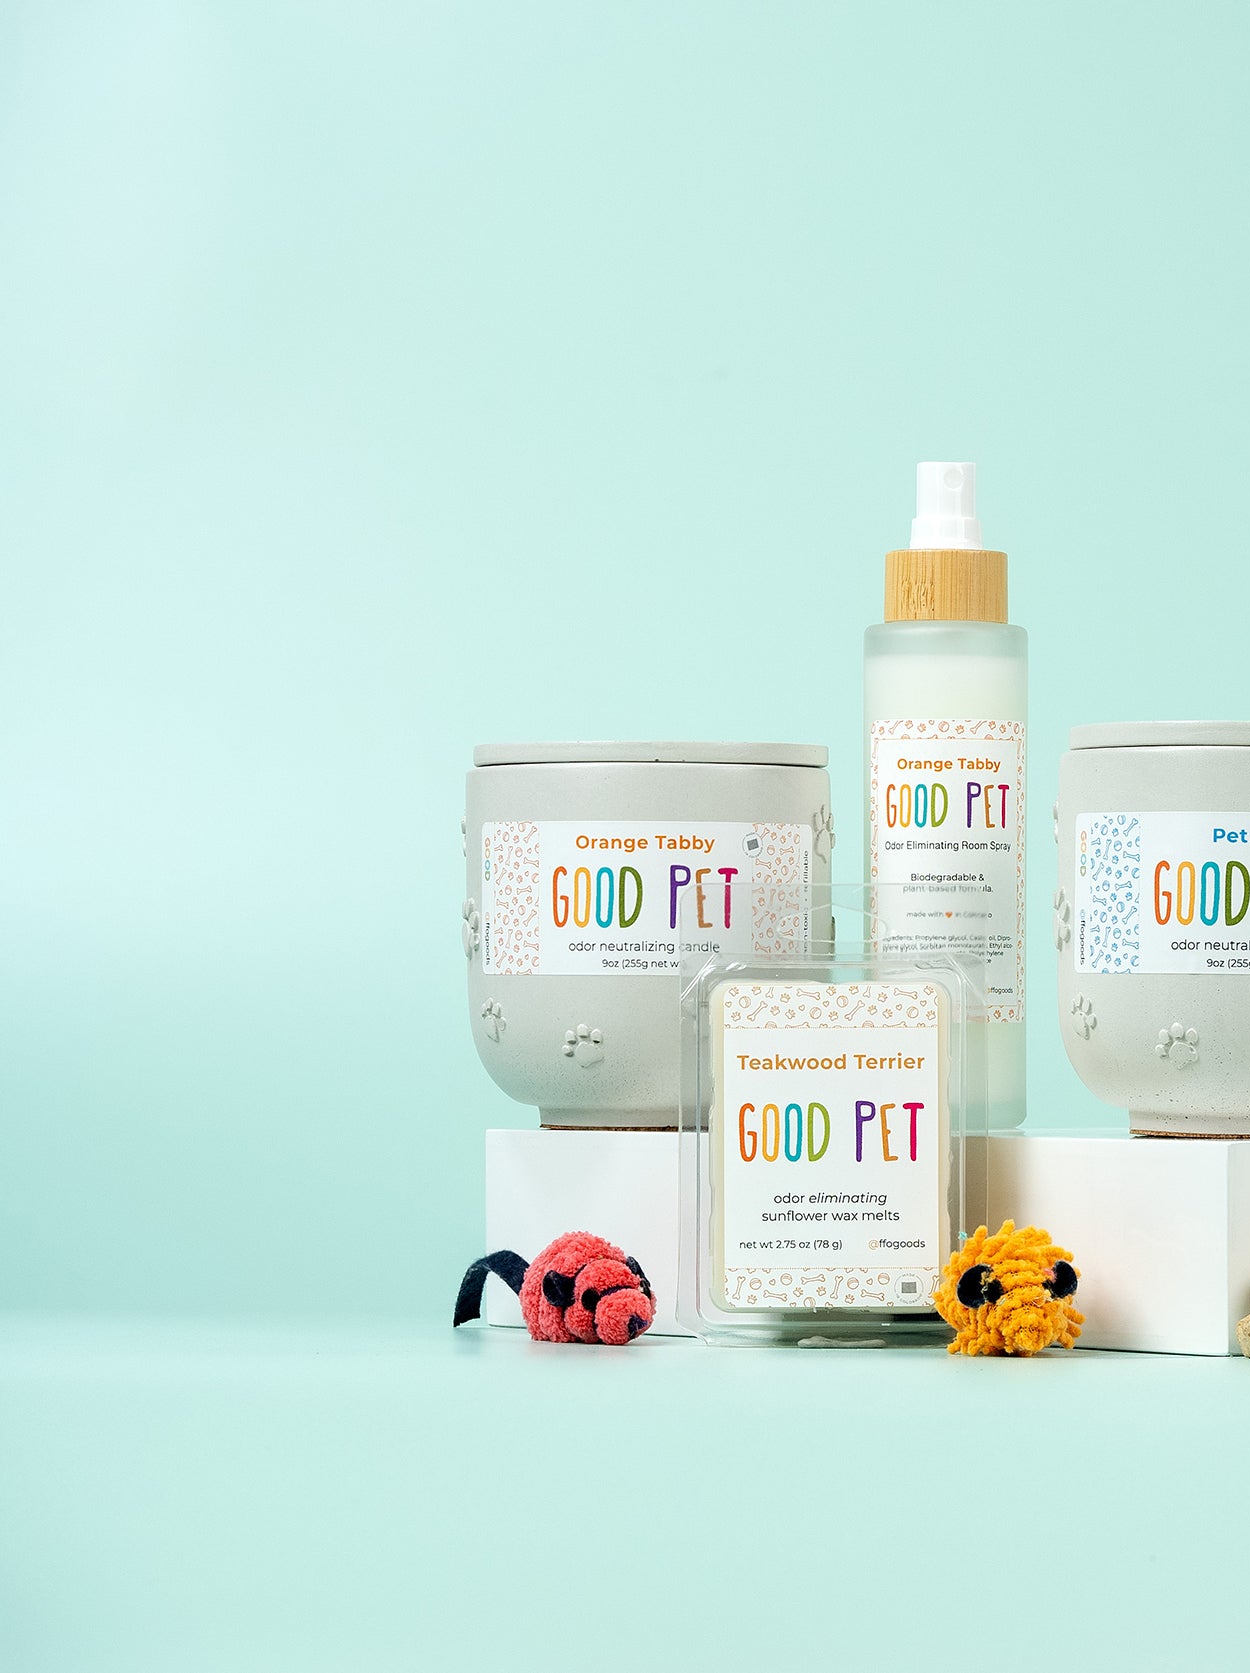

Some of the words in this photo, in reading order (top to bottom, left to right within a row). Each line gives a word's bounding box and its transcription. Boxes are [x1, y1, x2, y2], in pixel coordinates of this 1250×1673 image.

[897, 758, 953, 772] Orange
[958, 758, 1001, 773] Tabby
[886, 783, 948, 828] GOOD
[967, 782, 1010, 829] PET
[1213, 828, 1248, 843] Pet
[576, 835, 649, 853] Orange
[655, 835, 715, 853] Tabby
[885, 841, 904, 850] Odor
[906, 841, 959, 852] Eliminating
[962, 841, 988, 850] Room
[990, 841, 1011, 852] Spray
[910, 874, 977, 883] Biodegradable
[552, 866, 643, 929] GOOD
[670, 865, 739, 929] PET
[1154, 860, 1250, 926] GOOD
[568, 941, 596, 952] odor
[600, 941, 675, 954] neutralizing
[678, 941, 720, 953] candle
[989, 942, 1002, 951] Ethyl
[1171, 939, 1200, 951] odor
[602, 959, 619, 968] 9oz
[622, 959, 648, 970] (255g
[651, 960, 667, 969] net
[1206, 958, 1225, 968] 9oz
[736, 1054, 847, 1070] Teakwood
[854, 1052, 925, 1070] Terrier
[739, 1102, 831, 1163] GOOD
[856, 1100, 925, 1163] PET
[774, 1193, 805, 1204] odor
[808, 1192, 888, 1206] eliminating
[762, 1210, 828, 1222] sunflower
[832, 1213, 859, 1222] wax
[862, 1210, 900, 1222] melts
[739, 1240, 757, 1250] net
[760, 1240, 773, 1250] wt
[776, 1240, 797, 1250] 2.75
[798, 1242, 811, 1250] oz
[813, 1240, 830, 1251] (78
[832, 1240, 843, 1251] g)
[868, 1238, 926, 1251] @ffogoods
